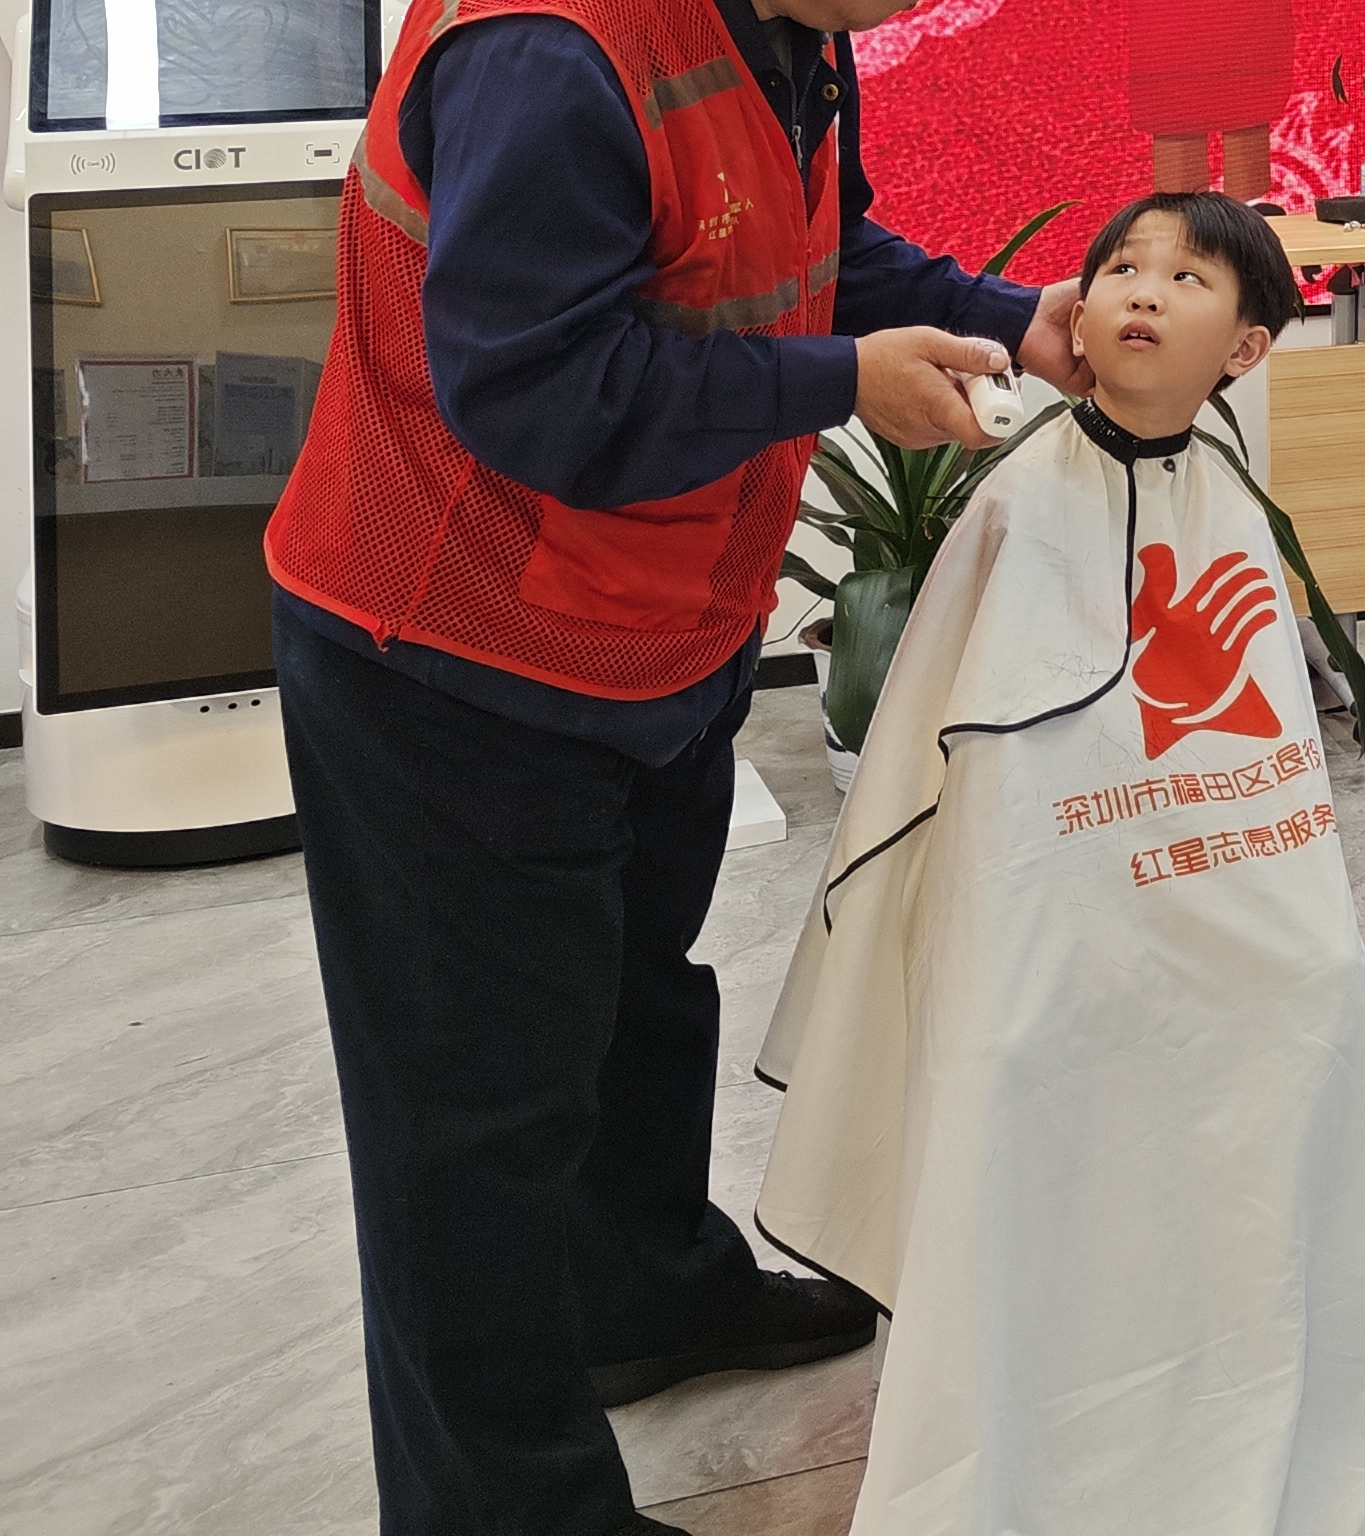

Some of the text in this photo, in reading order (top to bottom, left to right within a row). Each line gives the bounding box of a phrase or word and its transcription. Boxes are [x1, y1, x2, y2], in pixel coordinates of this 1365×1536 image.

[1129, 802, 1339, 888] 红星志愿服务
